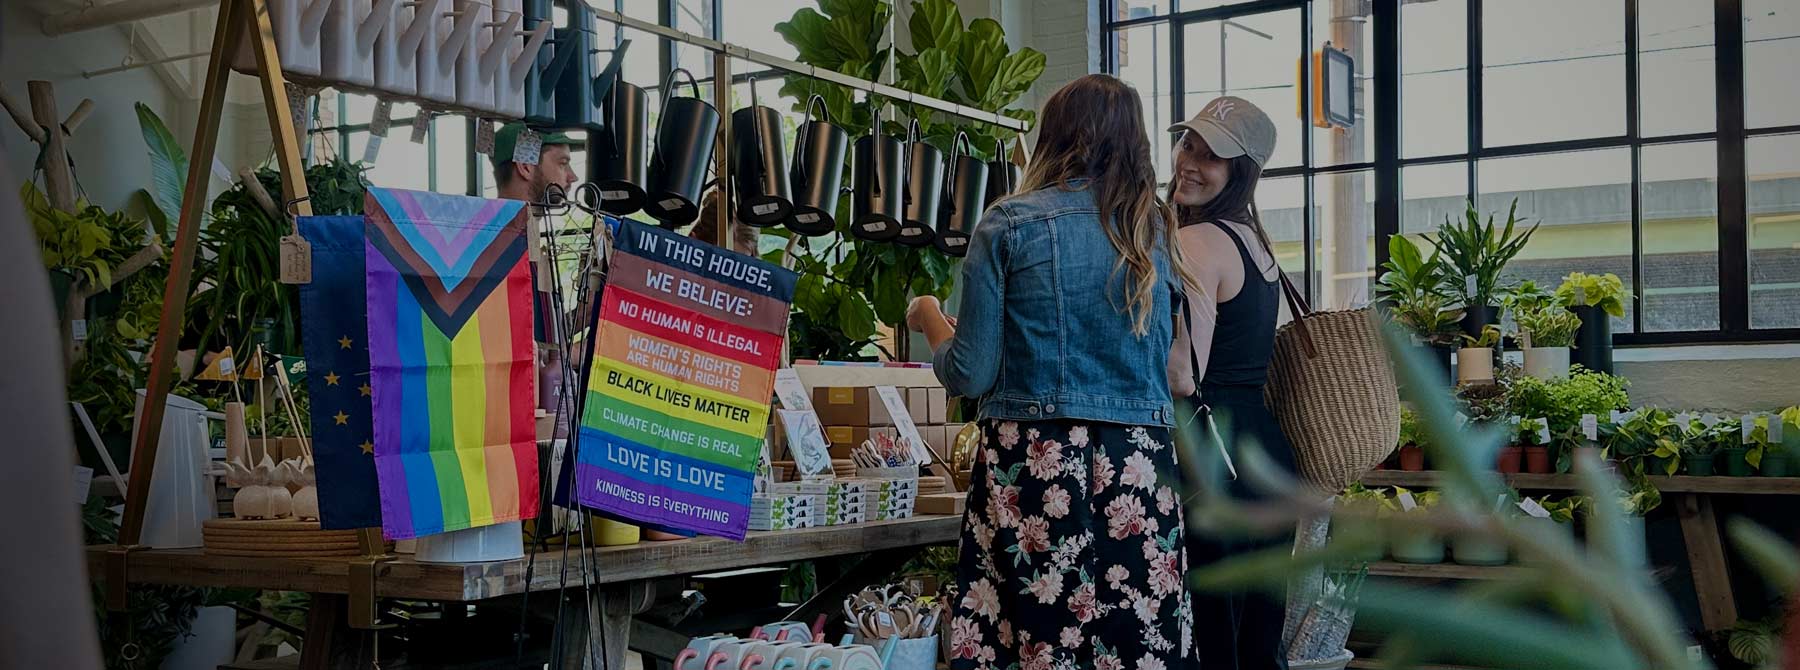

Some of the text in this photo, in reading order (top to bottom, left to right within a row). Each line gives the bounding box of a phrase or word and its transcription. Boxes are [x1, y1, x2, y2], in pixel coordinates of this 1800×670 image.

[639, 231, 773, 292] IN THIS HOUSE,
[646, 269, 753, 316] WE BELIEVE:
[618, 300, 762, 356] NO HUMAN IS ILLEGAL
[627, 350, 740, 392] ARE HUMAN RIGHTS
[629, 333, 742, 379] WOMEN'S RIGHTS
[607, 370, 750, 423] BLACK LIVES MATTER
[603, 407, 743, 458] CLIMATE CHANGE IS REAL
[607, 443, 725, 491] LOVE IS LOVE
[595, 479, 730, 524] KINDNESS IS EVERYTHING
